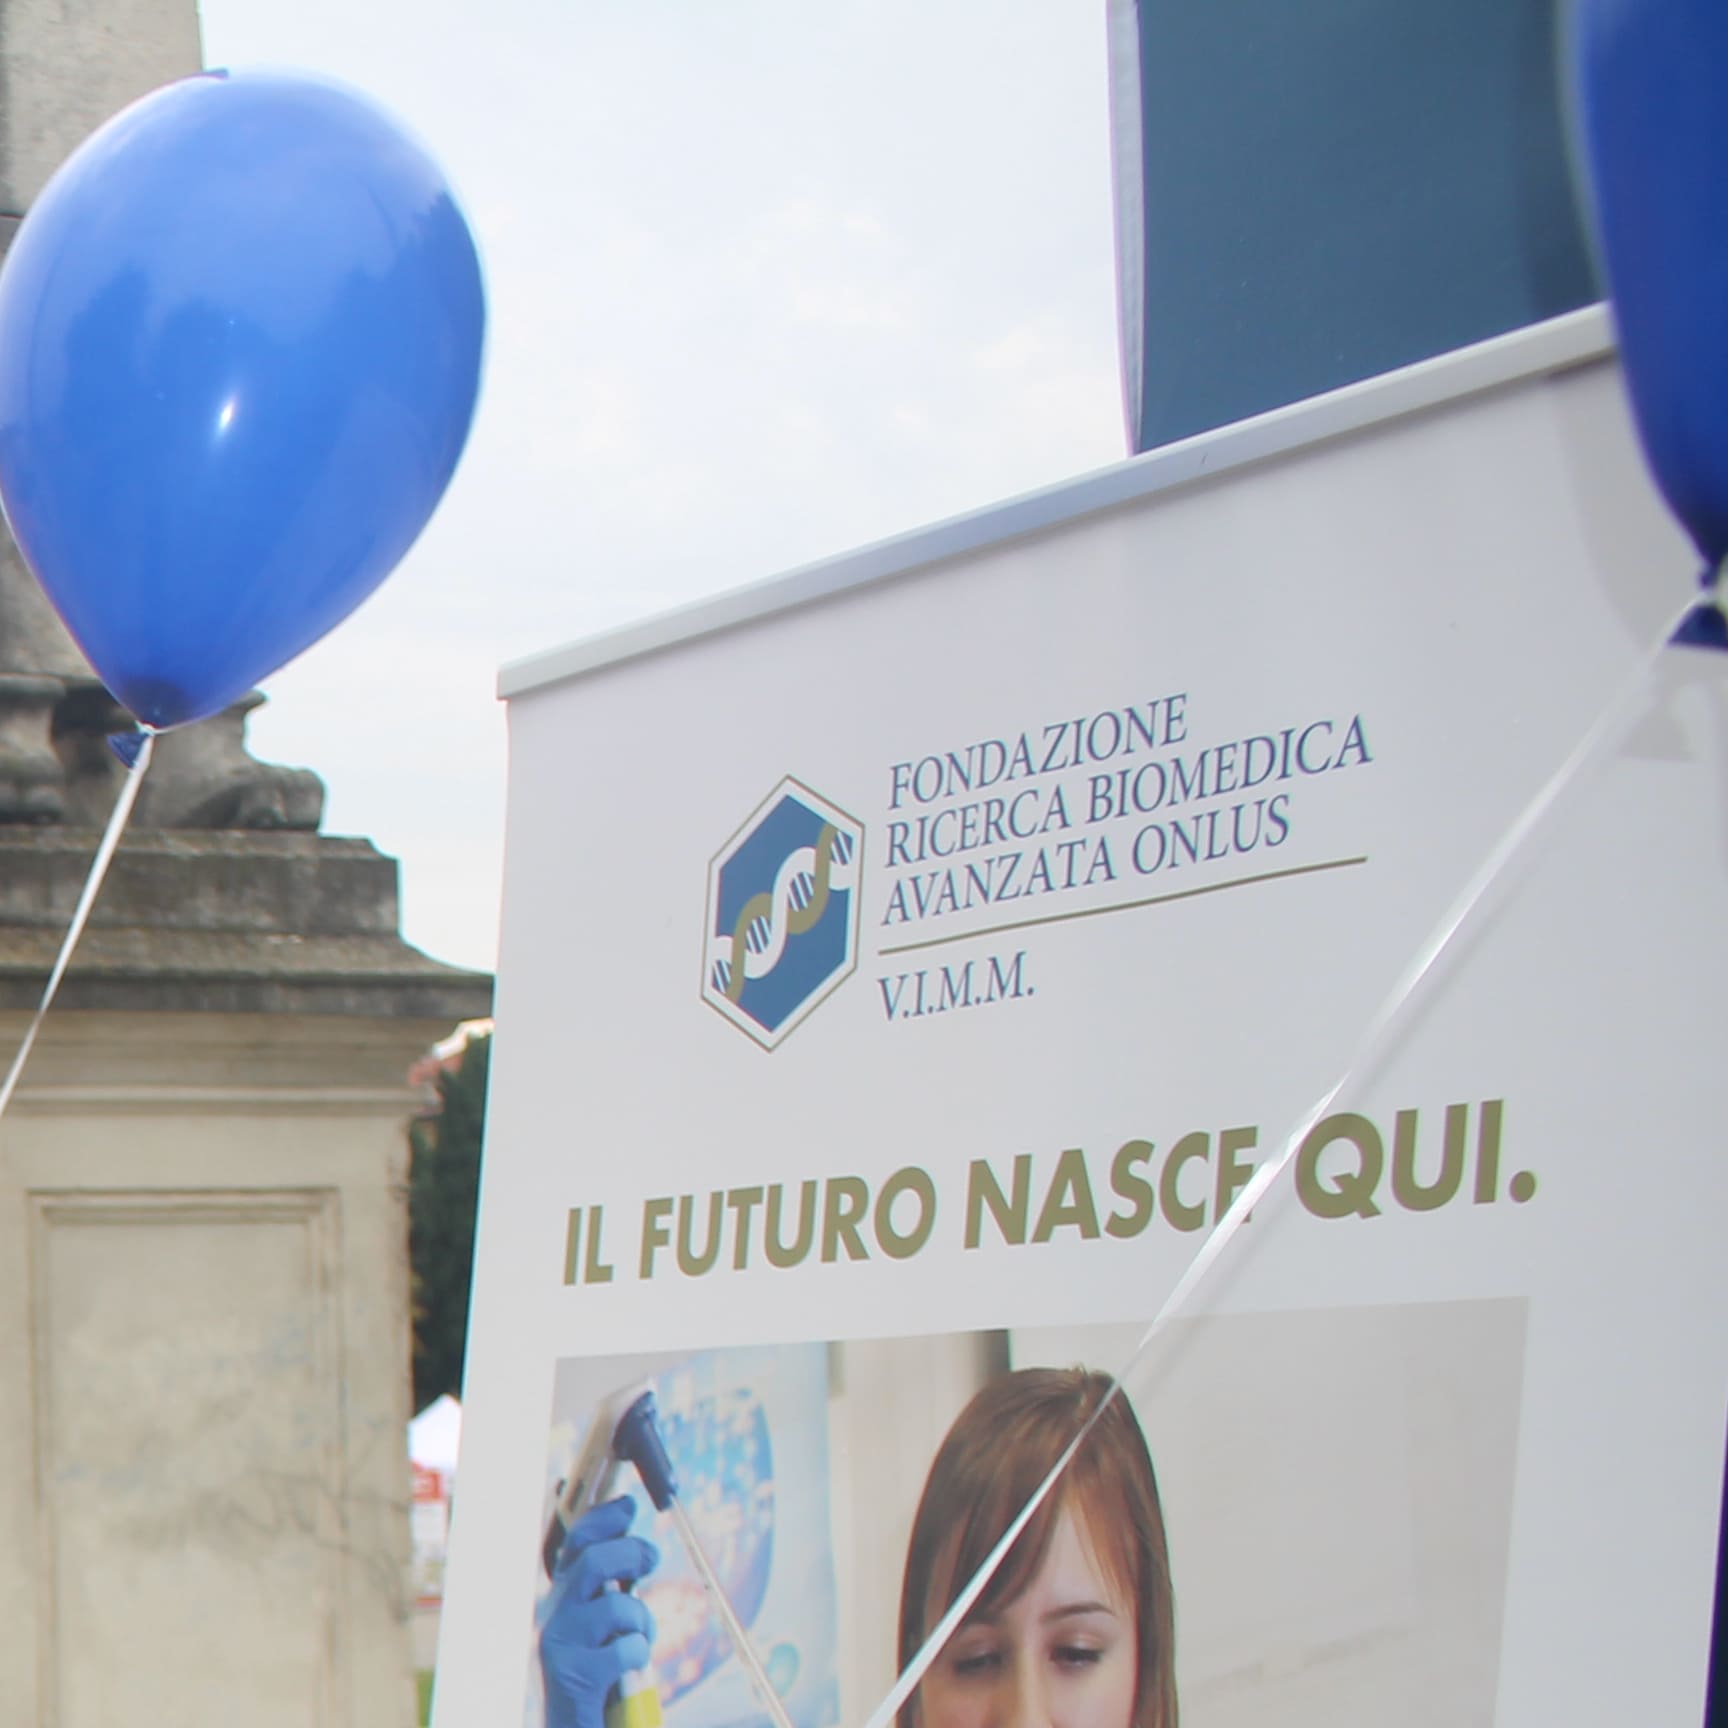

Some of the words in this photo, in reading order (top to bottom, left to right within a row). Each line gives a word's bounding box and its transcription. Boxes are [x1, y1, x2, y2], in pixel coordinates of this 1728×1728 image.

[885, 784, 1072, 868] RICERCA
[1085, 714, 1373, 824] BIOMEDICA
[888, 693, 1188, 810] FONDAZIONE
[881, 836, 1117, 926] AVANZATA
[1132, 794, 1291, 875] ONLUS
[878, 952, 1035, 1022] V.I.M.M.
[562, 1205, 615, 1287] IL
[638, 1166, 938, 1282] FUTURO
[963, 1125, 1260, 1250] NASCE
[1294, 1098, 1538, 1220] QUI.
